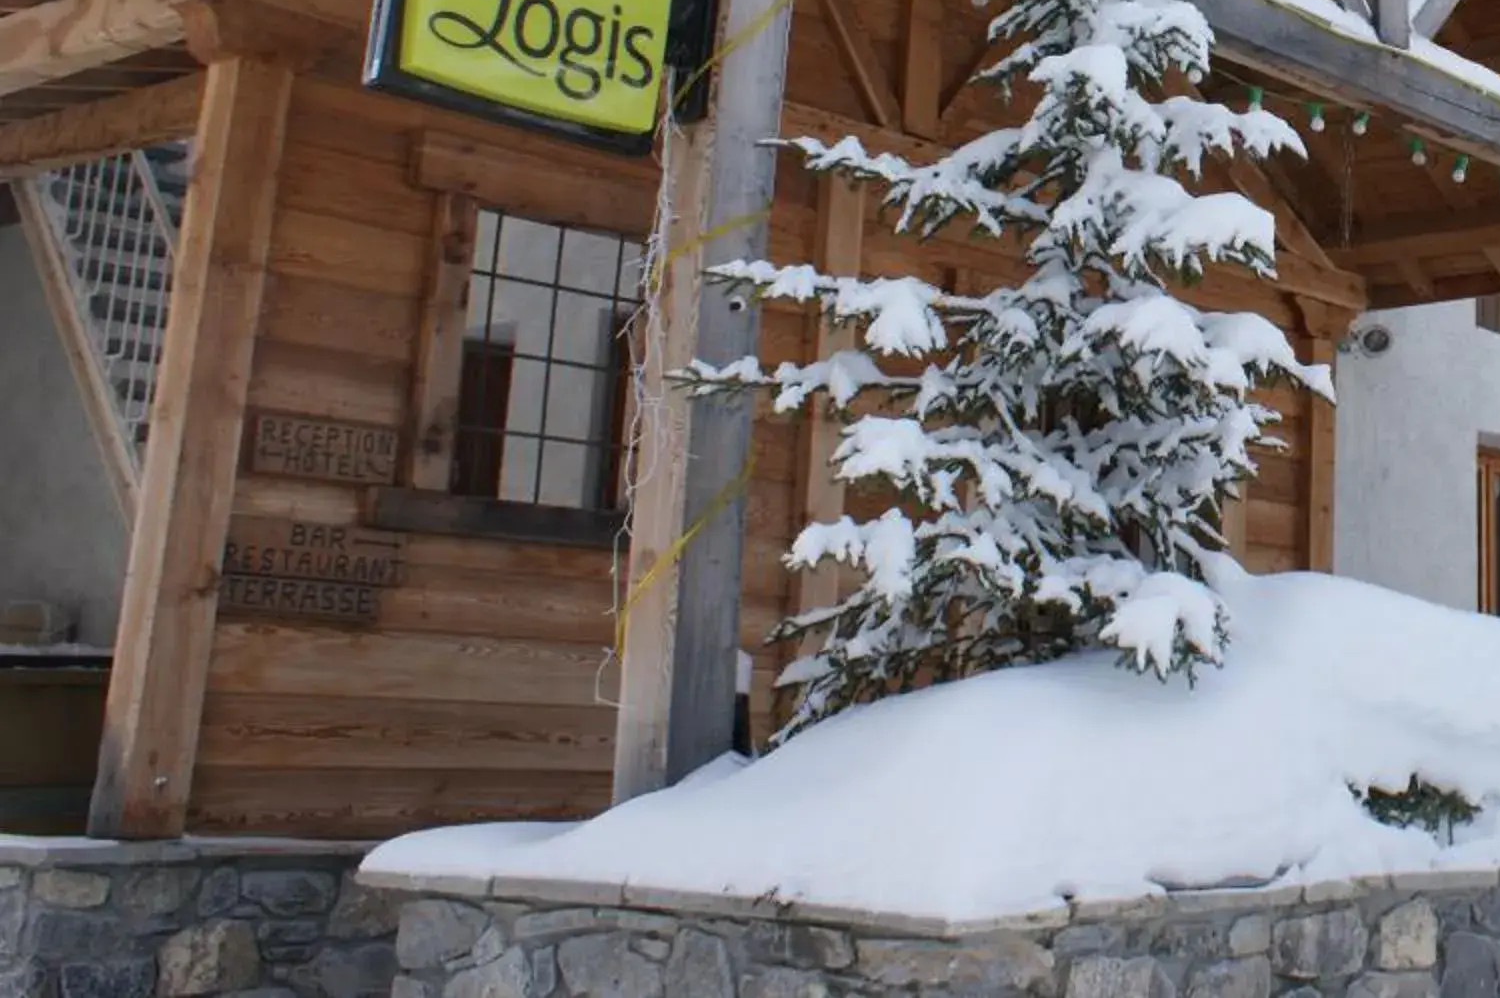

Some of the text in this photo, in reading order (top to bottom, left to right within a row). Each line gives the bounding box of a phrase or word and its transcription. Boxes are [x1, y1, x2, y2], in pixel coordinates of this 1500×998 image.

[290, 523, 346, 549] BAR
[226, 542, 406, 585] RESTAURANT
[227, 576, 373, 614] TERRASSE
